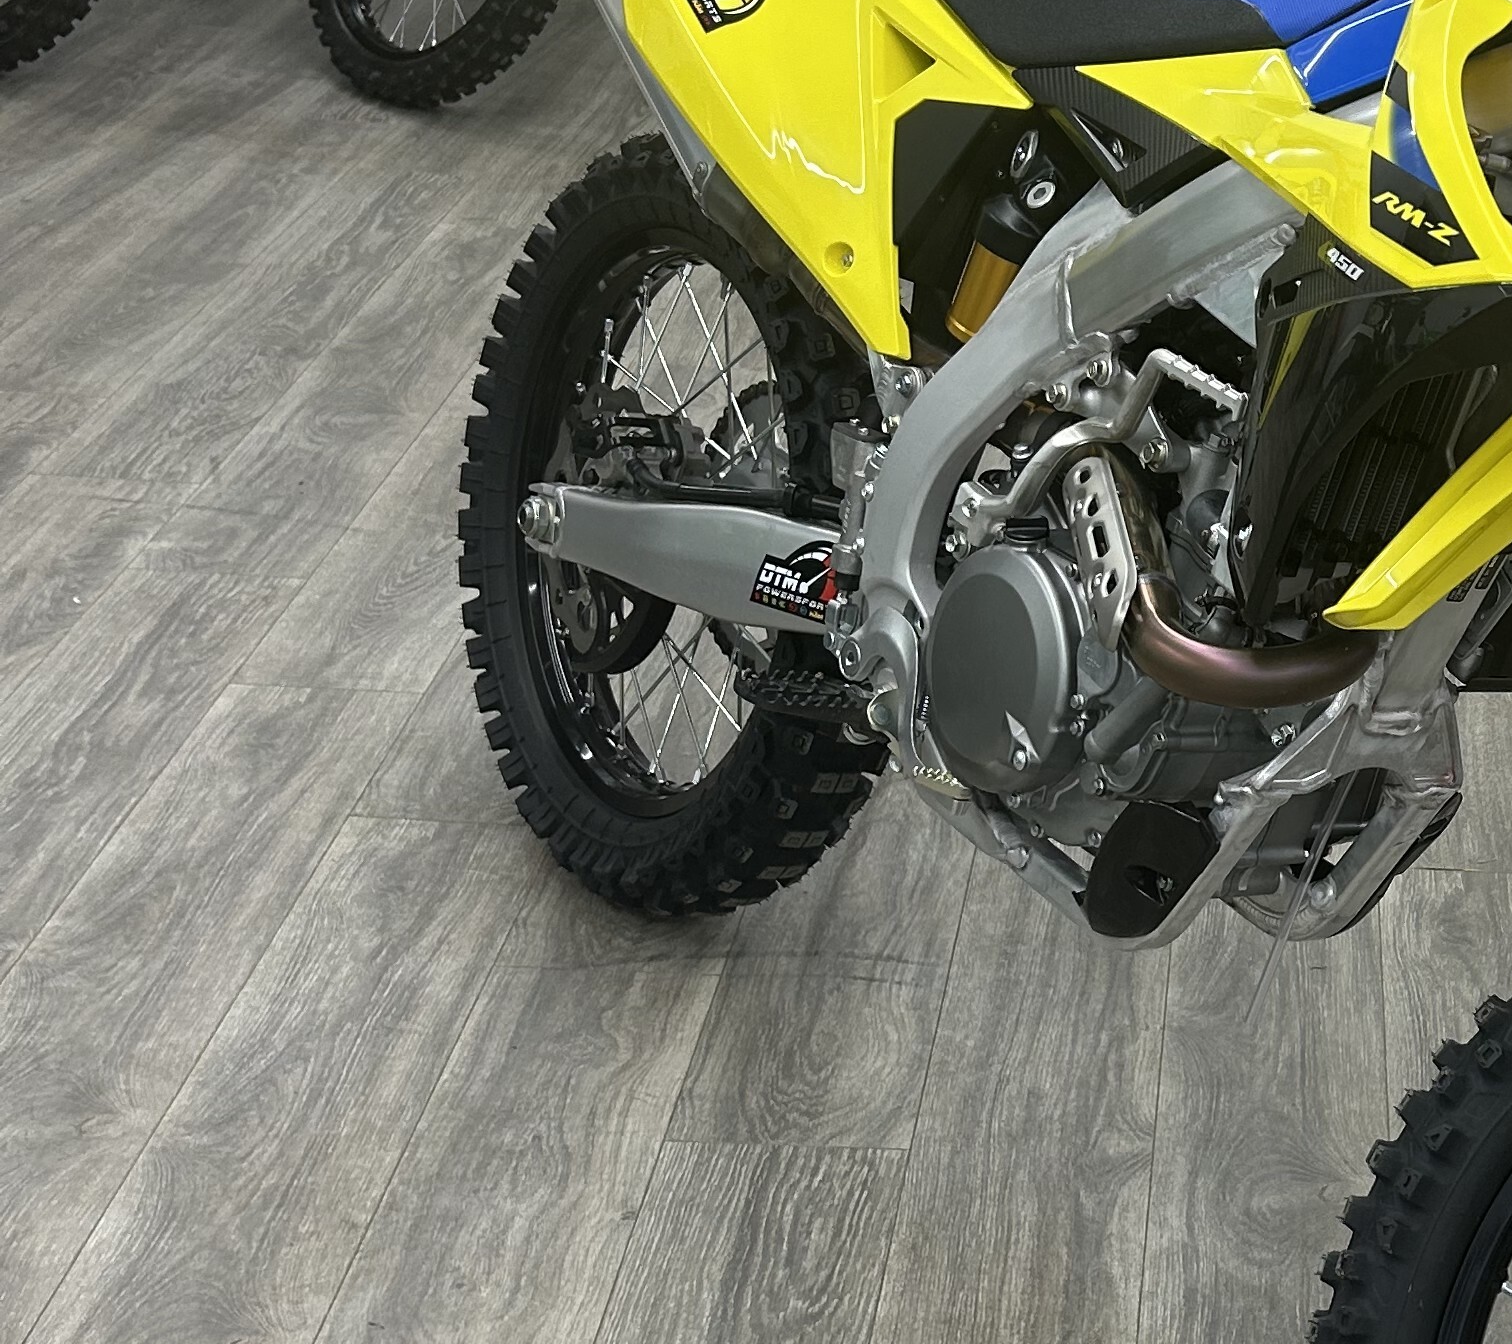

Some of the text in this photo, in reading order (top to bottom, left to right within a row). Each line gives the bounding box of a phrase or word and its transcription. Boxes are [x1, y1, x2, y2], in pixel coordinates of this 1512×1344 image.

[1372, 191, 1460, 247] RM-Z
[1326, 247, 1365, 281] 450
[755, 583, 828, 611] POWERSPOR
